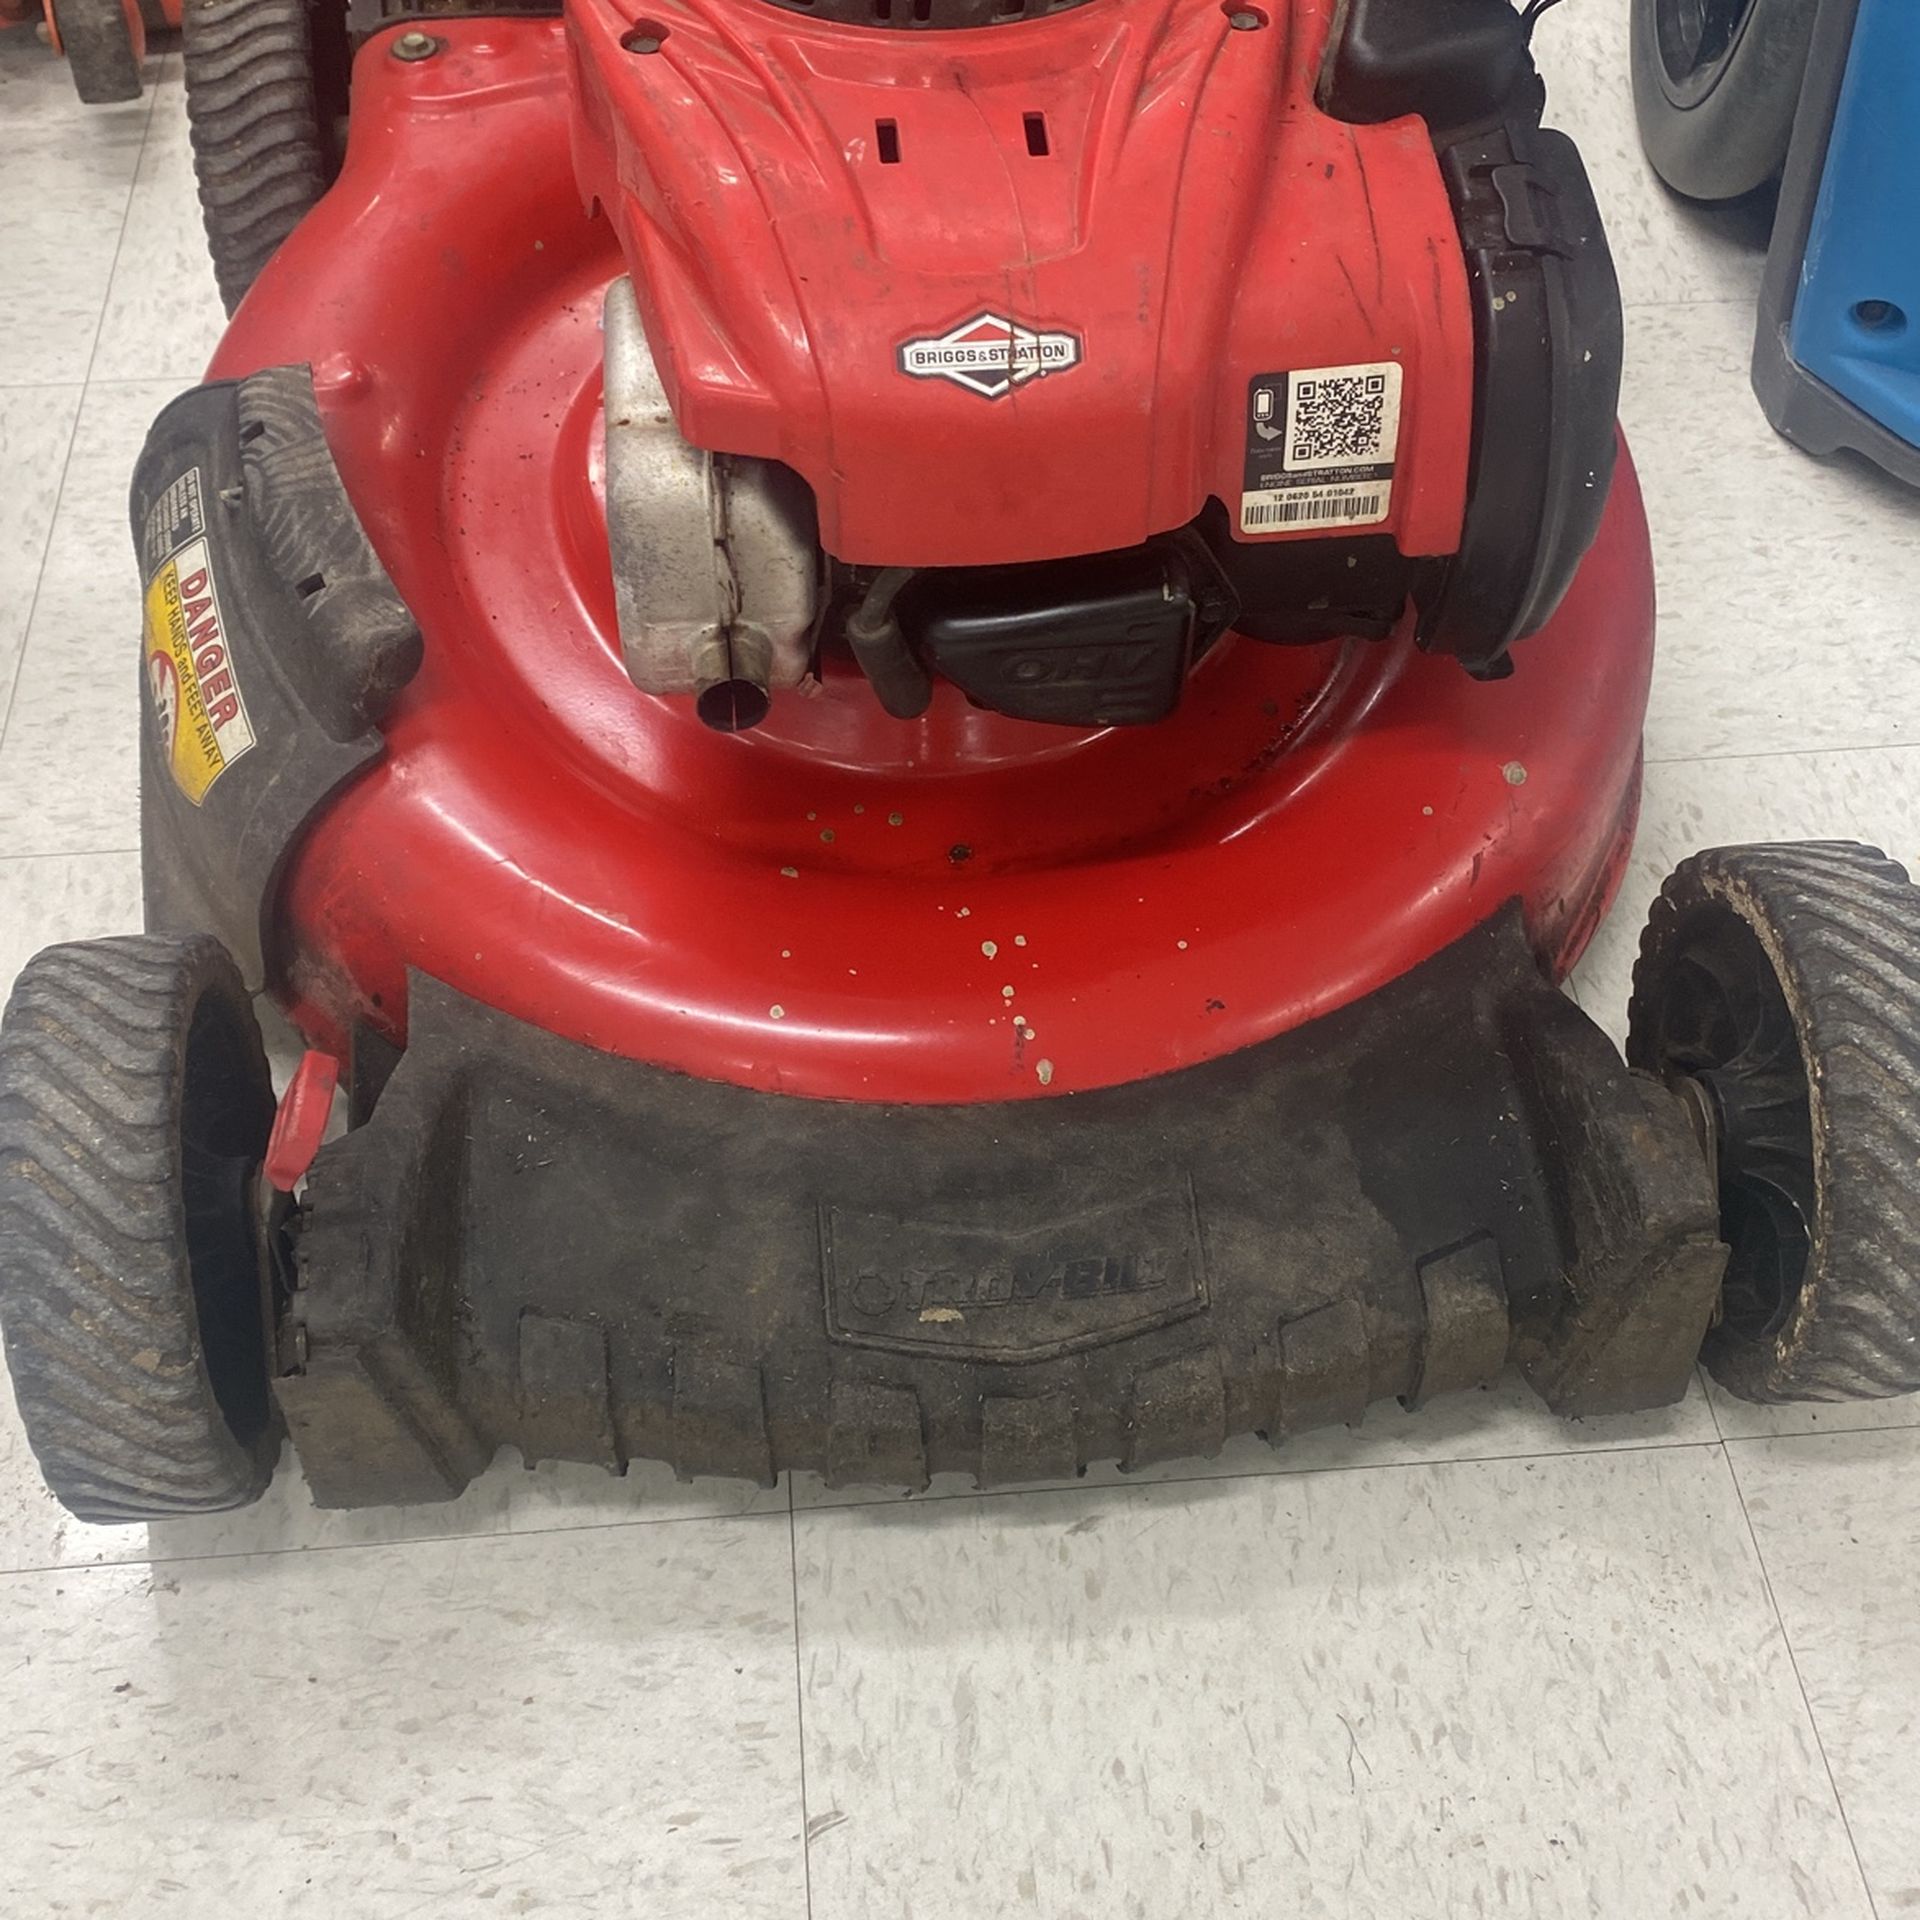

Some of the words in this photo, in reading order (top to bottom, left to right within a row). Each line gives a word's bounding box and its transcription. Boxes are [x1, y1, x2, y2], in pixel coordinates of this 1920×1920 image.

[163, 568, 178, 606] KEEP
[167, 607, 188, 657] HANDS
[180, 568, 239, 732] DANGER
[177, 658, 193, 685] and
[183, 683, 205, 723] FEET
[196, 722, 222, 769] AWAY
